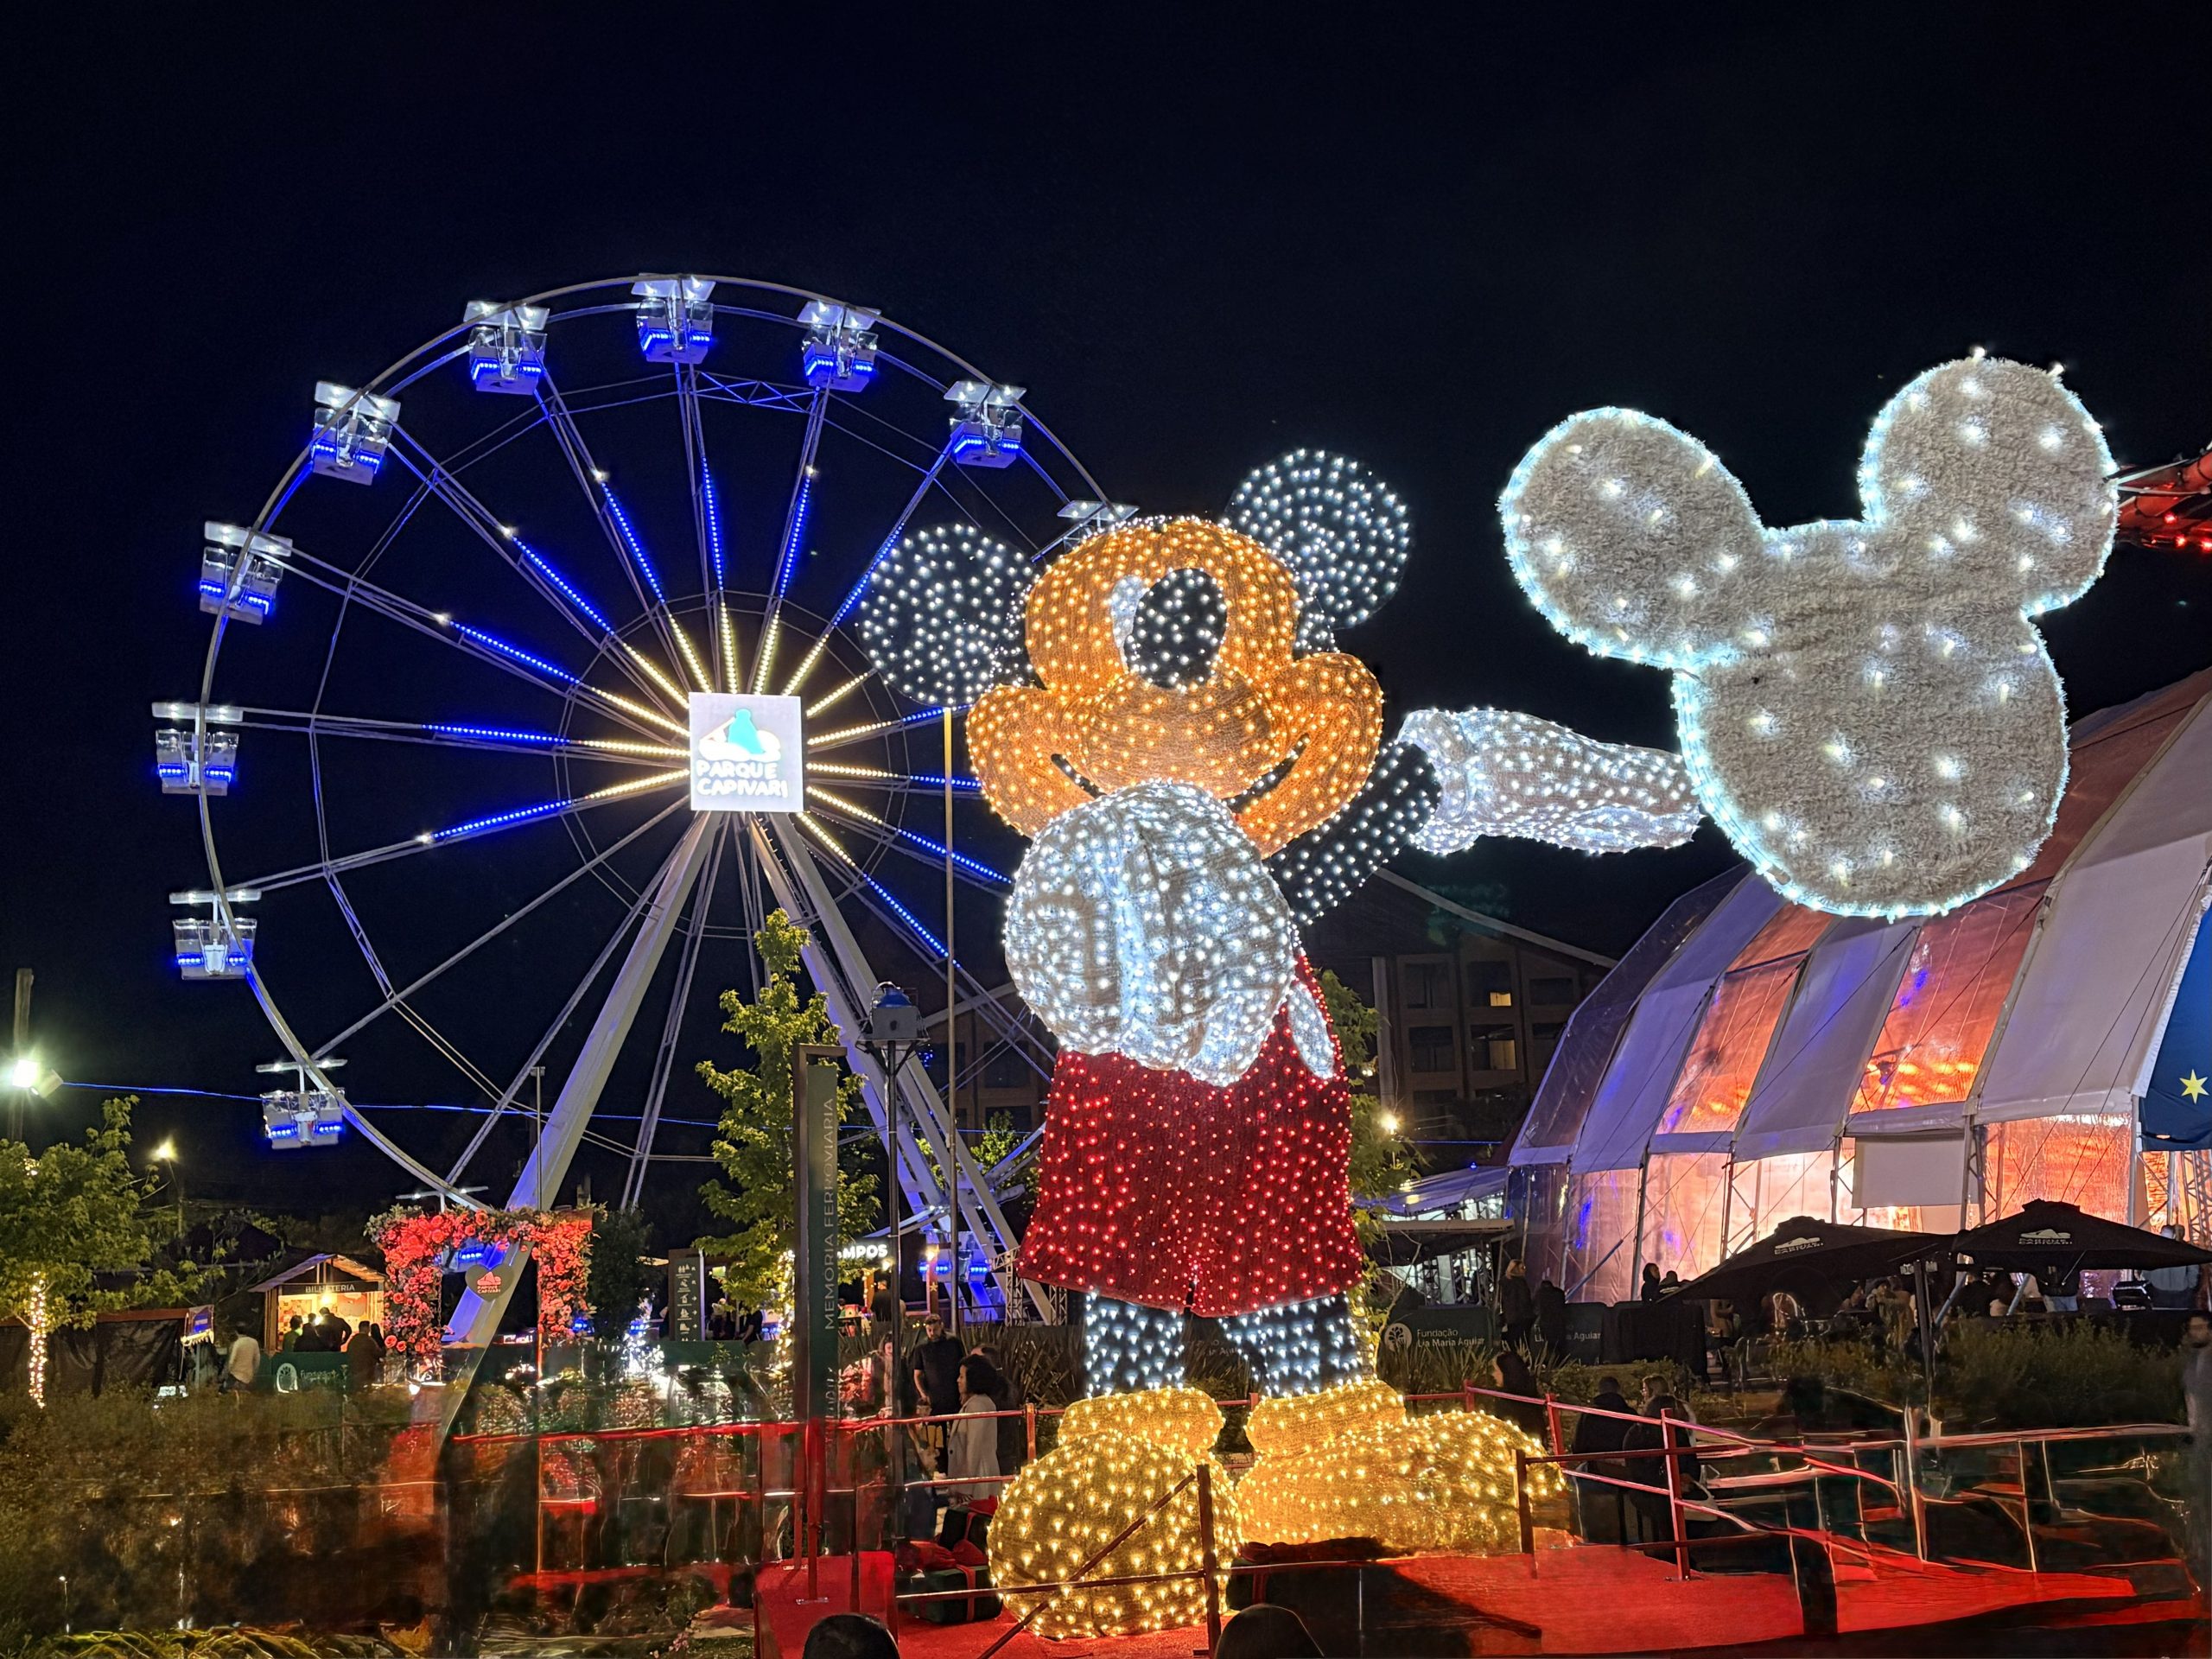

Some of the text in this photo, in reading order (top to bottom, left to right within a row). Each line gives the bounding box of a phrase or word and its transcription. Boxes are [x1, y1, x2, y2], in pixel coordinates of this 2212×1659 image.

[696, 760, 777, 779] PARQUE
[696, 779, 788, 798] CAPIVARI
[305, 1284, 355, 1293] BILHETERIA
[1417, 1328, 1458, 1338] Fundação
[1433, 1338, 1456, 1346] Maria
[1458, 1337, 1484, 1347] Aguiar
